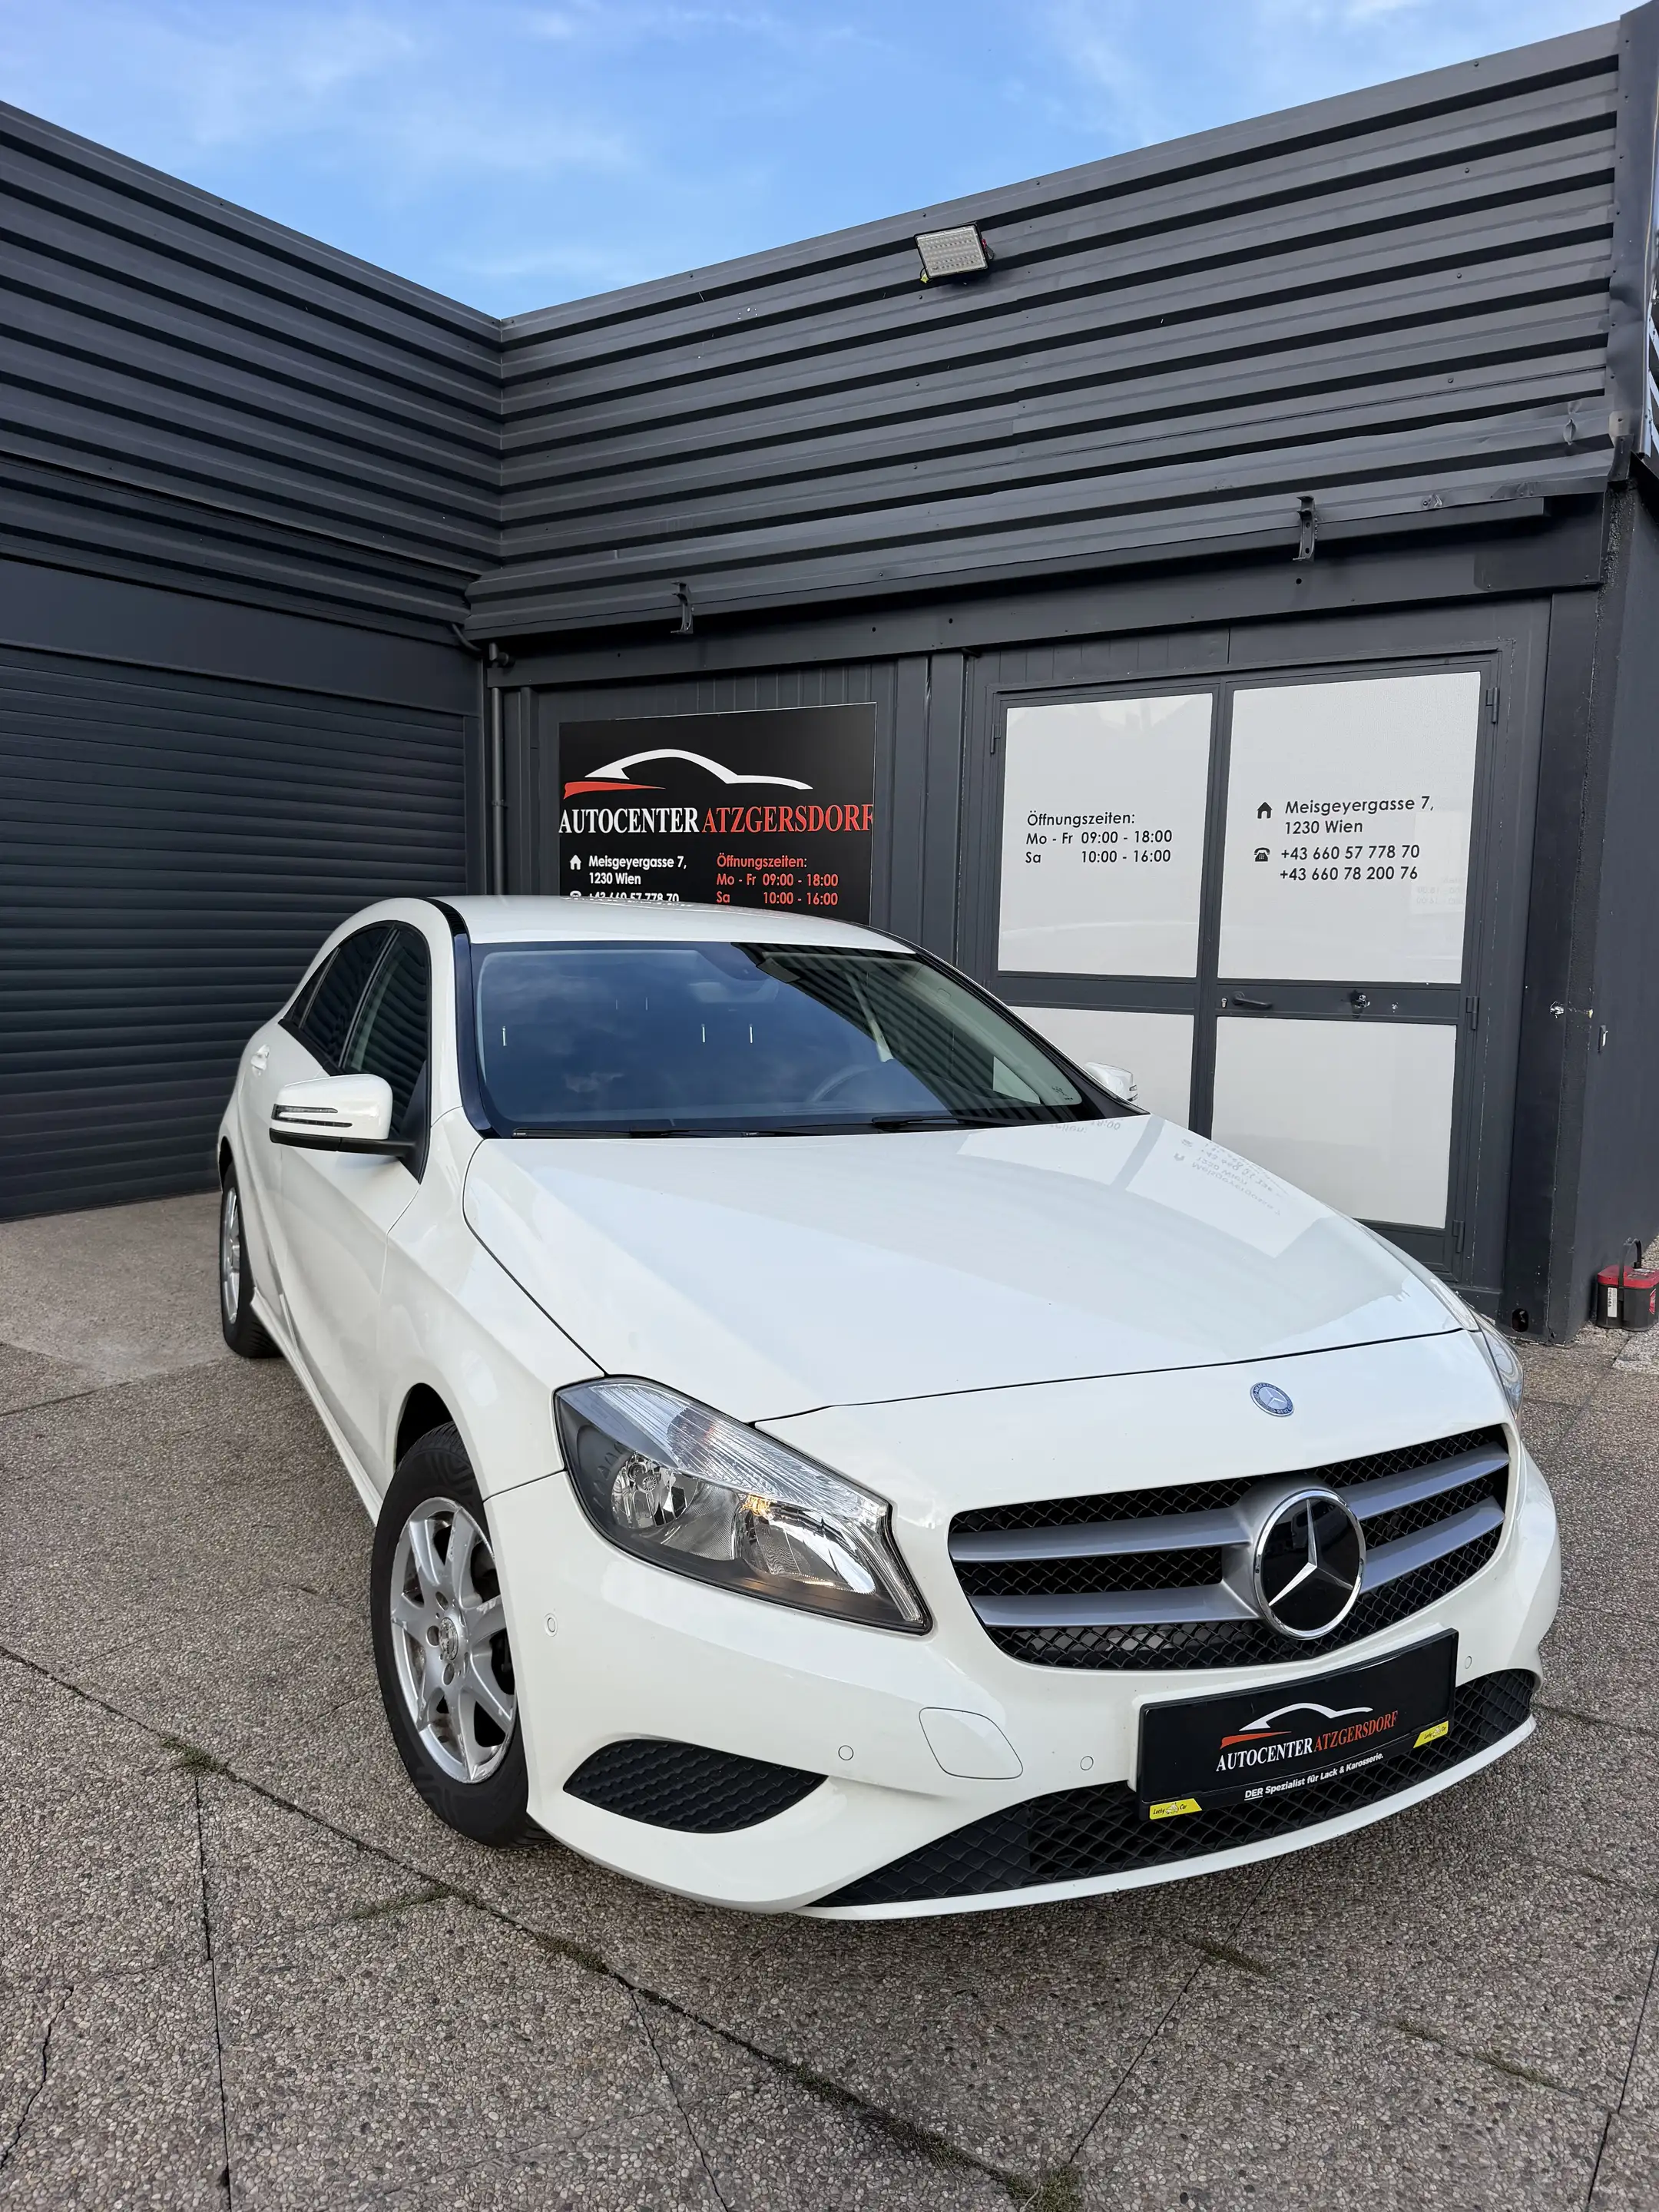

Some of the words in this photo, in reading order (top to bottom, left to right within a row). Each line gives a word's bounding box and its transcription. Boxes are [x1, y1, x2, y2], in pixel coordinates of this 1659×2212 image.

[1285, 799, 1415, 816] Meisgeyergasse
[1421, 796, 1434, 811] 7,
[558, 807, 700, 833] AUTOCENTER
[702, 804, 873, 833] ATZGERSDORF
[1027, 810, 1135, 828] Öffnungszeiten:
[1285, 821, 1320, 834] 1230
[1325, 820, 1363, 833] Wien
[1026, 833, 1047, 845] Mo
[1062, 833, 1073, 844] Fr
[1081, 831, 1118, 844] 09:00
[1134, 830, 1172, 843] 18:00
[1025, 851, 1041, 863] Sa
[1081, 850, 1118, 863] 10:00
[1134, 849, 1171, 863] 16:00
[1281, 847, 1307, 860] +43
[1313, 846, 1339, 859] 660
[1344, 846, 1363, 859] 57
[1368, 845, 1396, 859] 778
[1402, 845, 1420, 858] 70
[589, 855, 674, 870] Meisgeyergasse
[677, 856, 687, 869] 7,
[717, 853, 807, 870] Öffnungszeiten:
[589, 873, 613, 884] 1230
[615, 873, 641, 884] Wien
[717, 873, 734, 886] Mo
[747, 873, 757, 885] Fr
[762, 873, 794, 886] 09:00
[806, 873, 839, 886] 18:00
[1280, 868, 1306, 881] +43
[1312, 867, 1338, 880] 660
[1344, 866, 1362, 880] 78
[1366, 866, 1395, 879] 200
[1400, 866, 1418, 879] 76
[717, 891, 730, 903] Sa
[763, 892, 794, 905] 10:00
[806, 892, 839, 906] 16:00
[1216, 1737, 1313, 1772] AUTOCENTER
[1313, 1710, 1399, 1752] ATZGERSDORF
[1244, 1788, 1263, 1801] DER
[1265, 1778, 1306, 1795] Spezialist
[1307, 1773, 1319, 1784] für
[1320, 1768, 1338, 1780] Lack
[1339, 1765, 1345, 1773] &
[1346, 1752, 1384, 1772] Karosserie.
